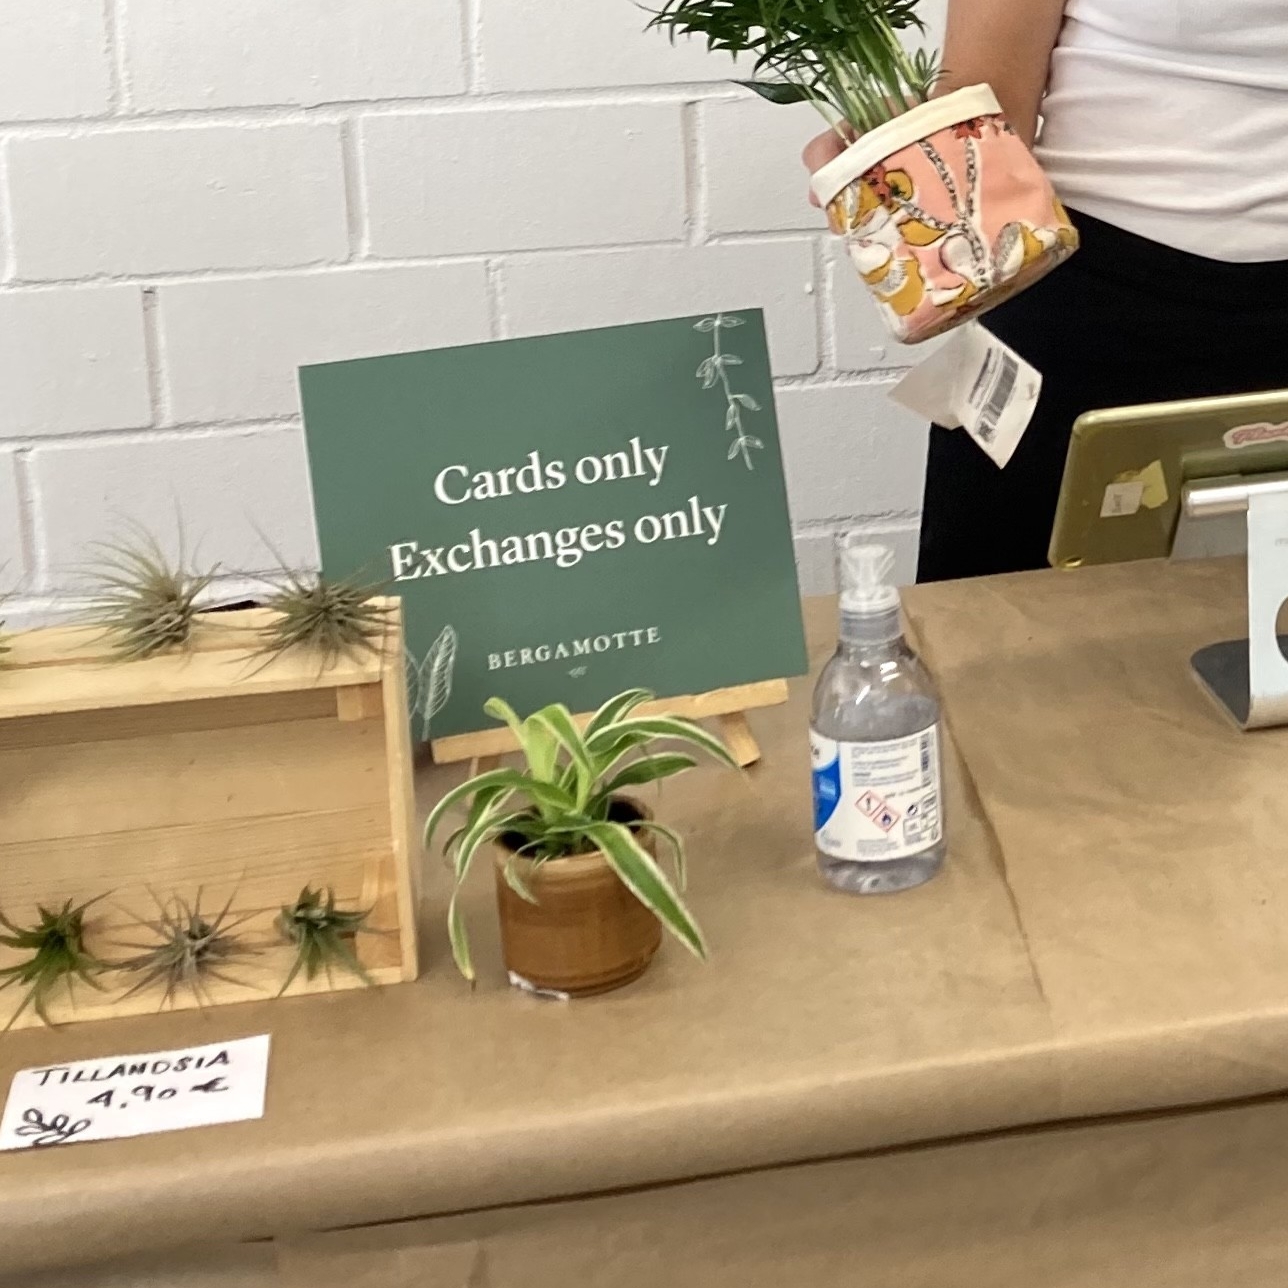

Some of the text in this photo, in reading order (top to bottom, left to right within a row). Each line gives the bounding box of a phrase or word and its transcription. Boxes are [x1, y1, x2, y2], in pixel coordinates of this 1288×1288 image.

[433, 436, 669, 505] Cards only
[389, 495, 728, 581] Exchanges only
[488, 626, 662, 670] BERGAMOTTE
